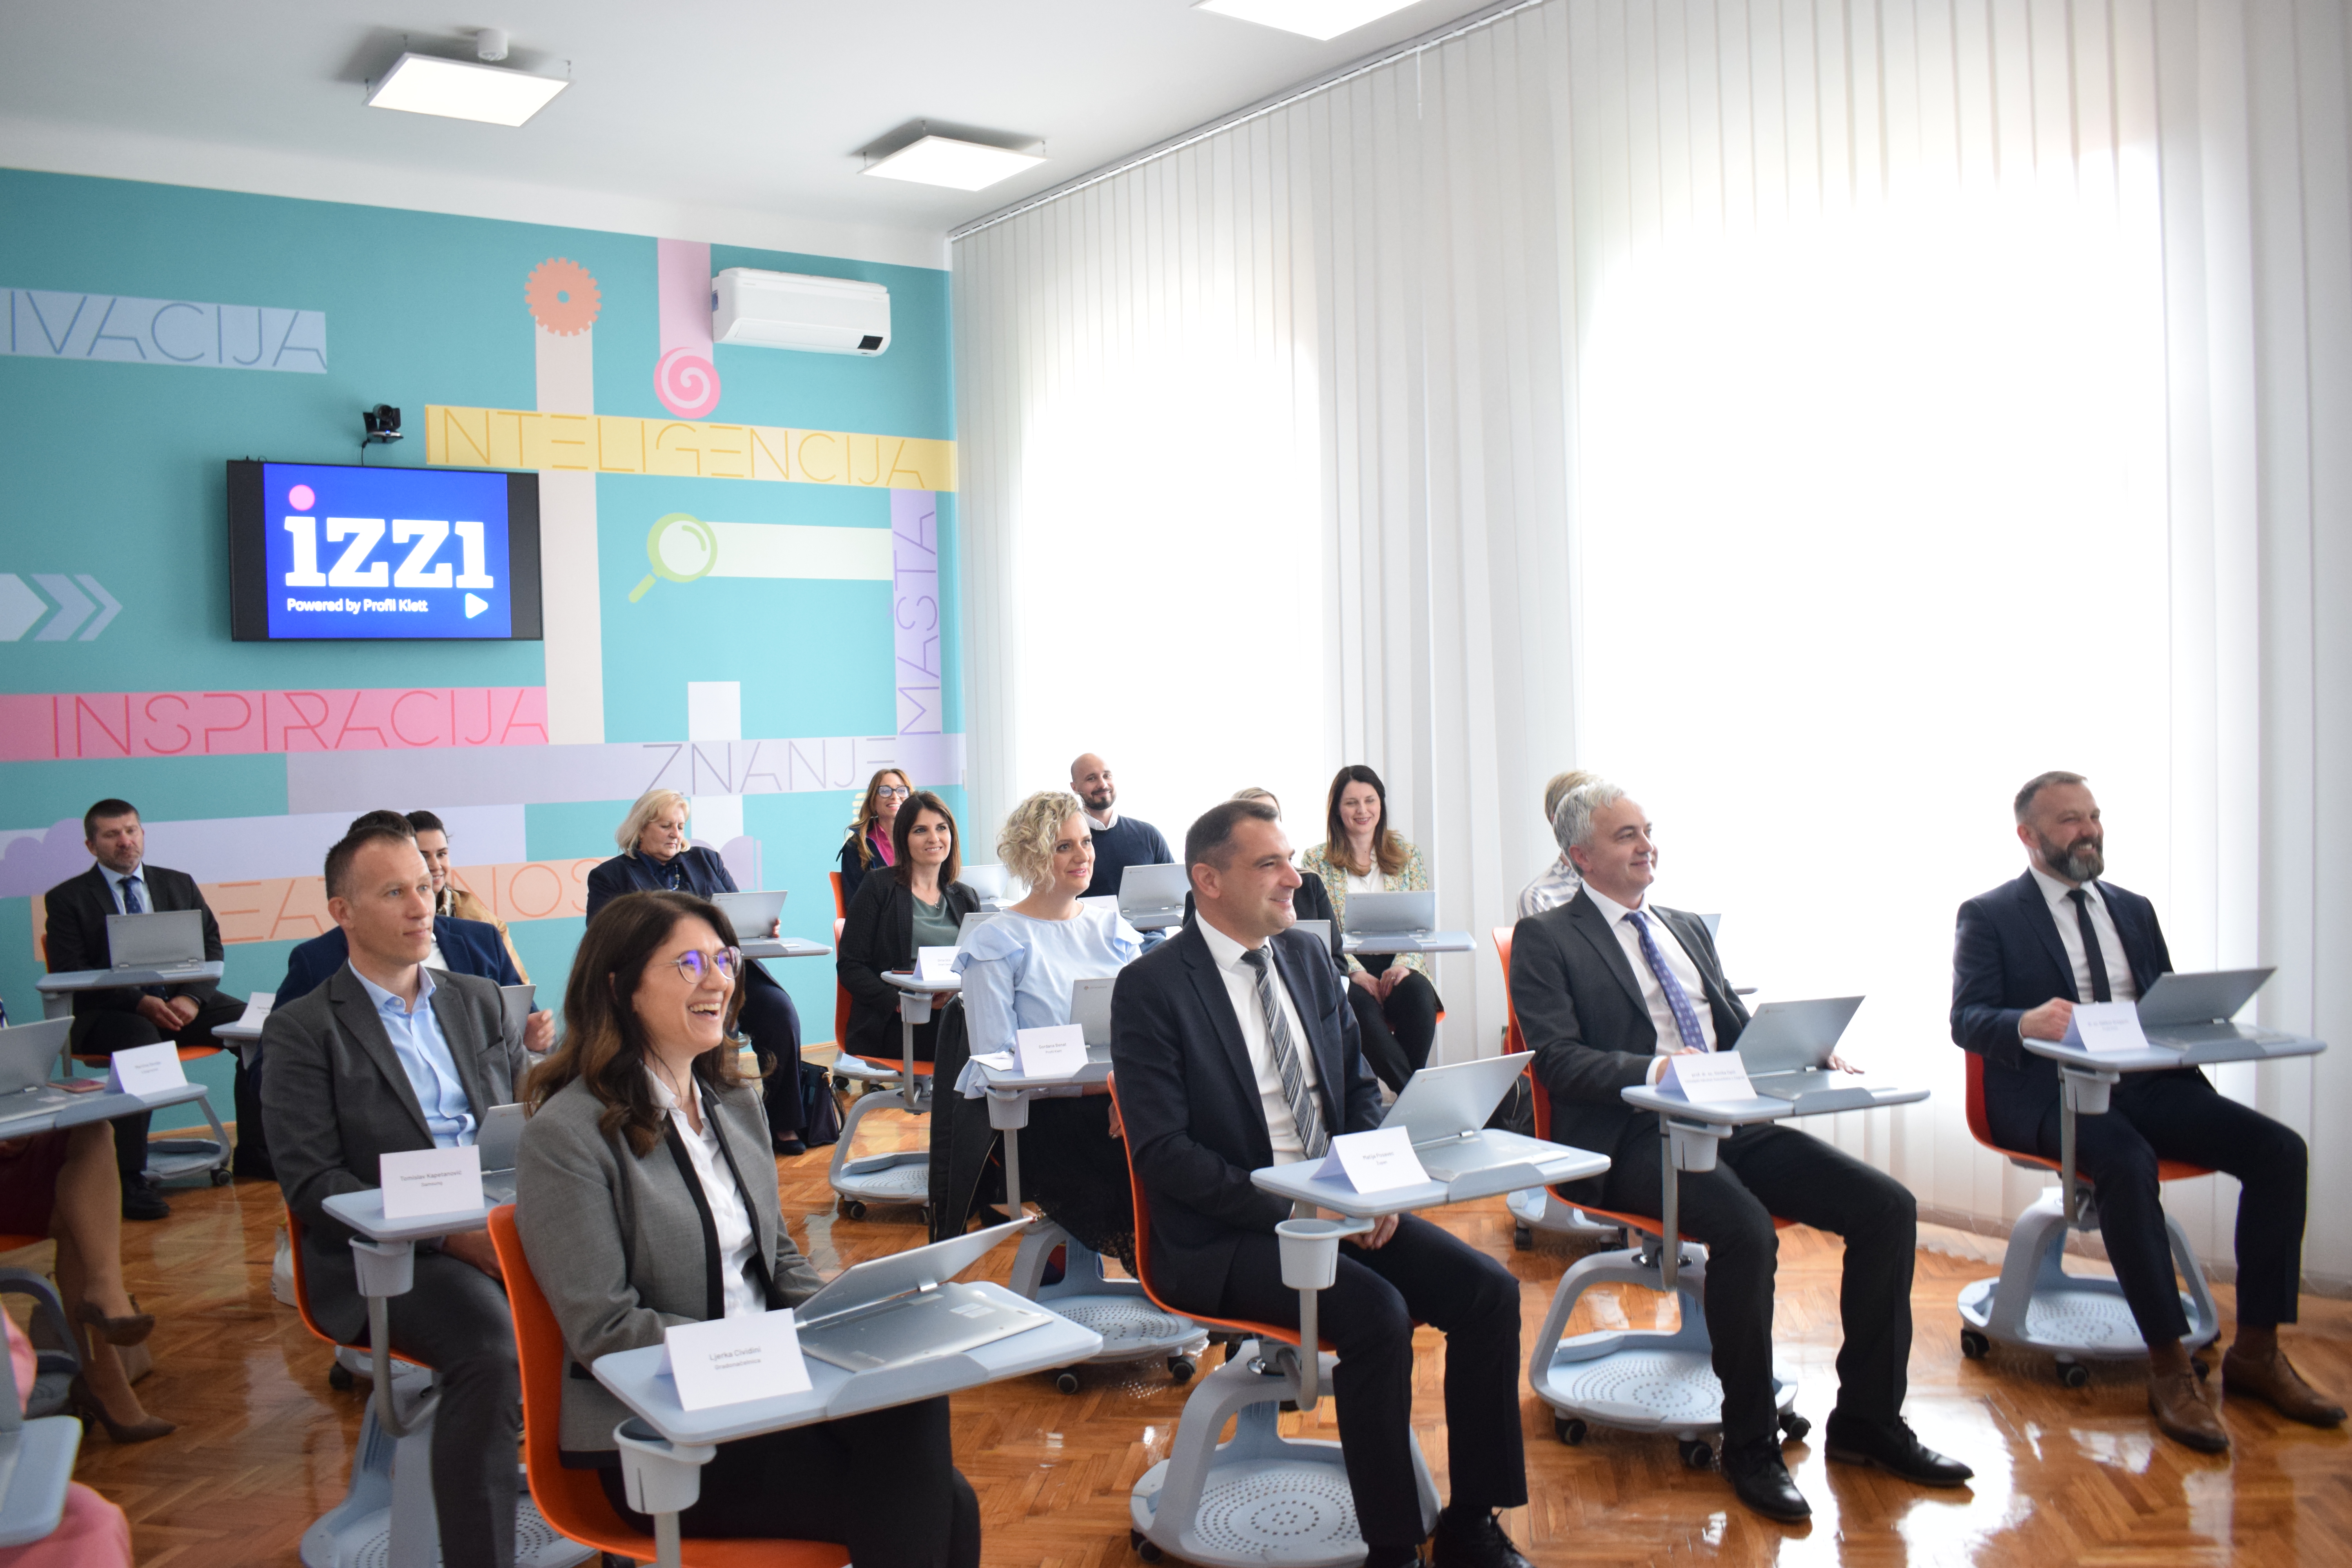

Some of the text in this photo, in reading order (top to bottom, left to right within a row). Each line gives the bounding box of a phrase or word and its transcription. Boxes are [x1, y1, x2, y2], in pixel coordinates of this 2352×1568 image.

[425, 407, 926, 489] INTELIGENCIJA
[287, 598, 428, 615] Powered by Profil Klett
[53, 689, 549, 757] INSPIRACIJA
[709, 1346, 762, 1361] Ljerka Cividini
